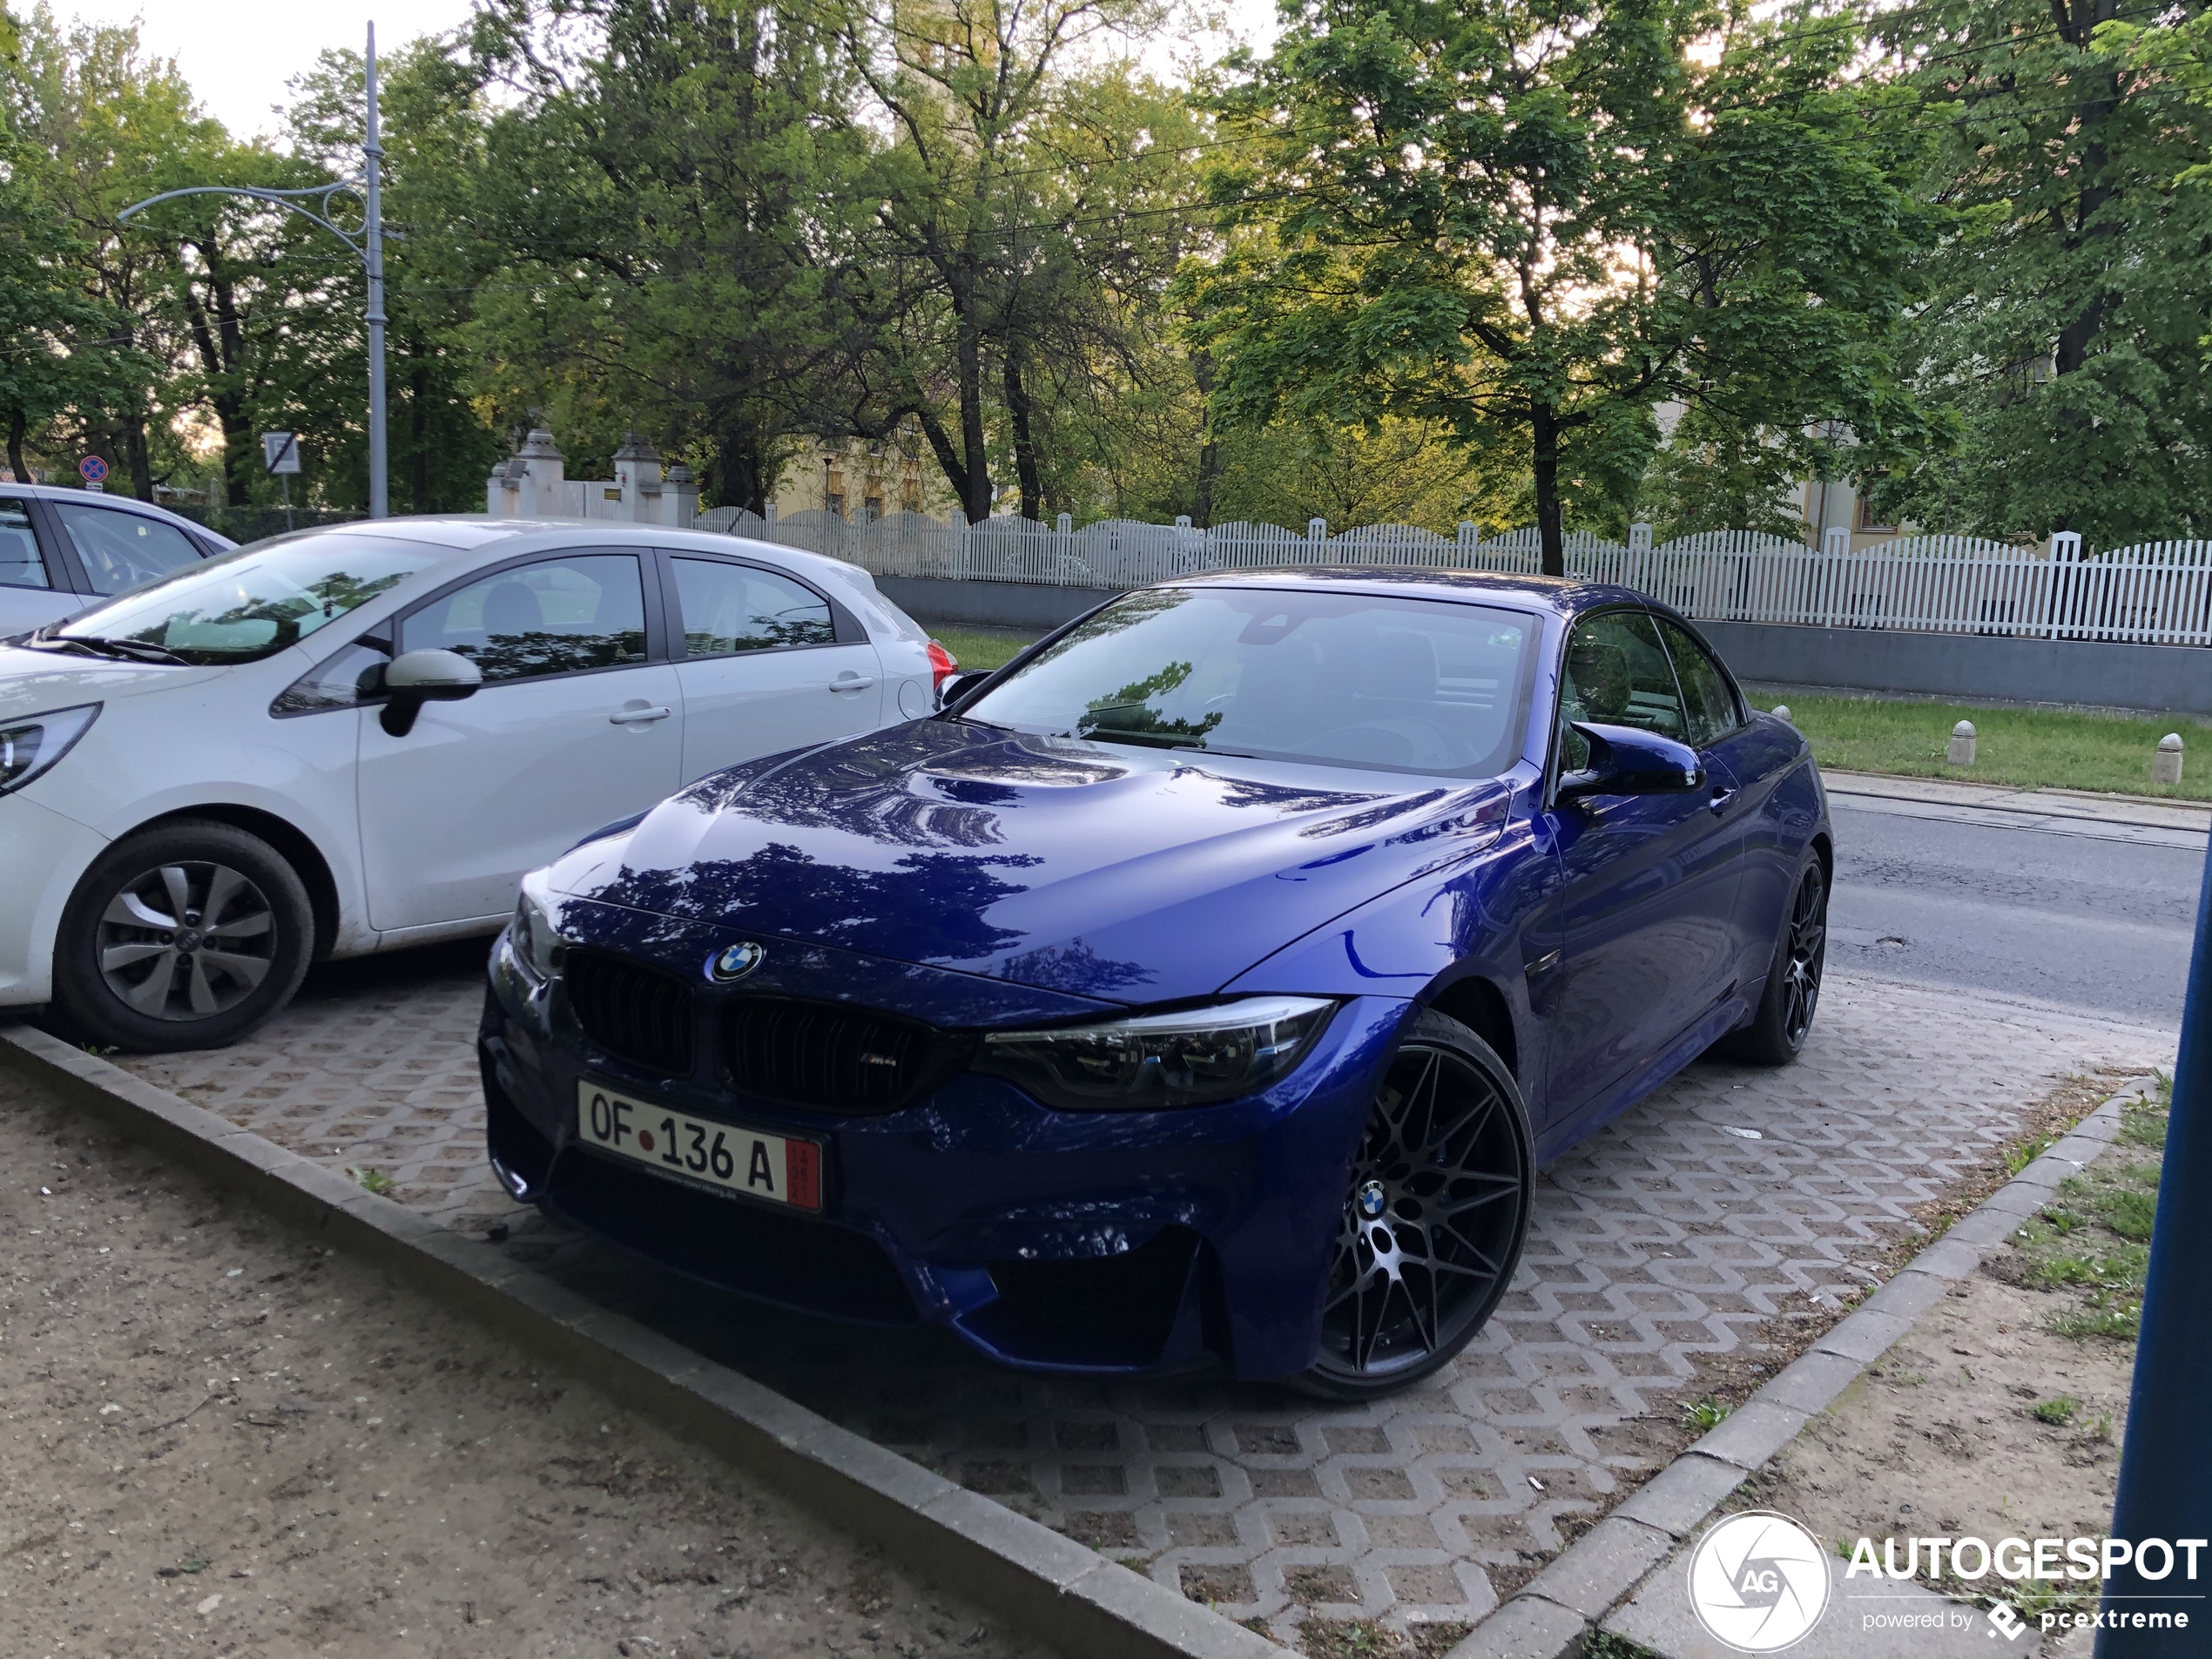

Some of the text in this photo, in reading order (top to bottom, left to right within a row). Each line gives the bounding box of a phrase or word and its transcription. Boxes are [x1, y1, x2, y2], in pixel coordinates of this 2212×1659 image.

[591, 1093, 633, 1145] OF
[661, 1117, 733, 1179] 136
[748, 1140, 774, 1191] A
